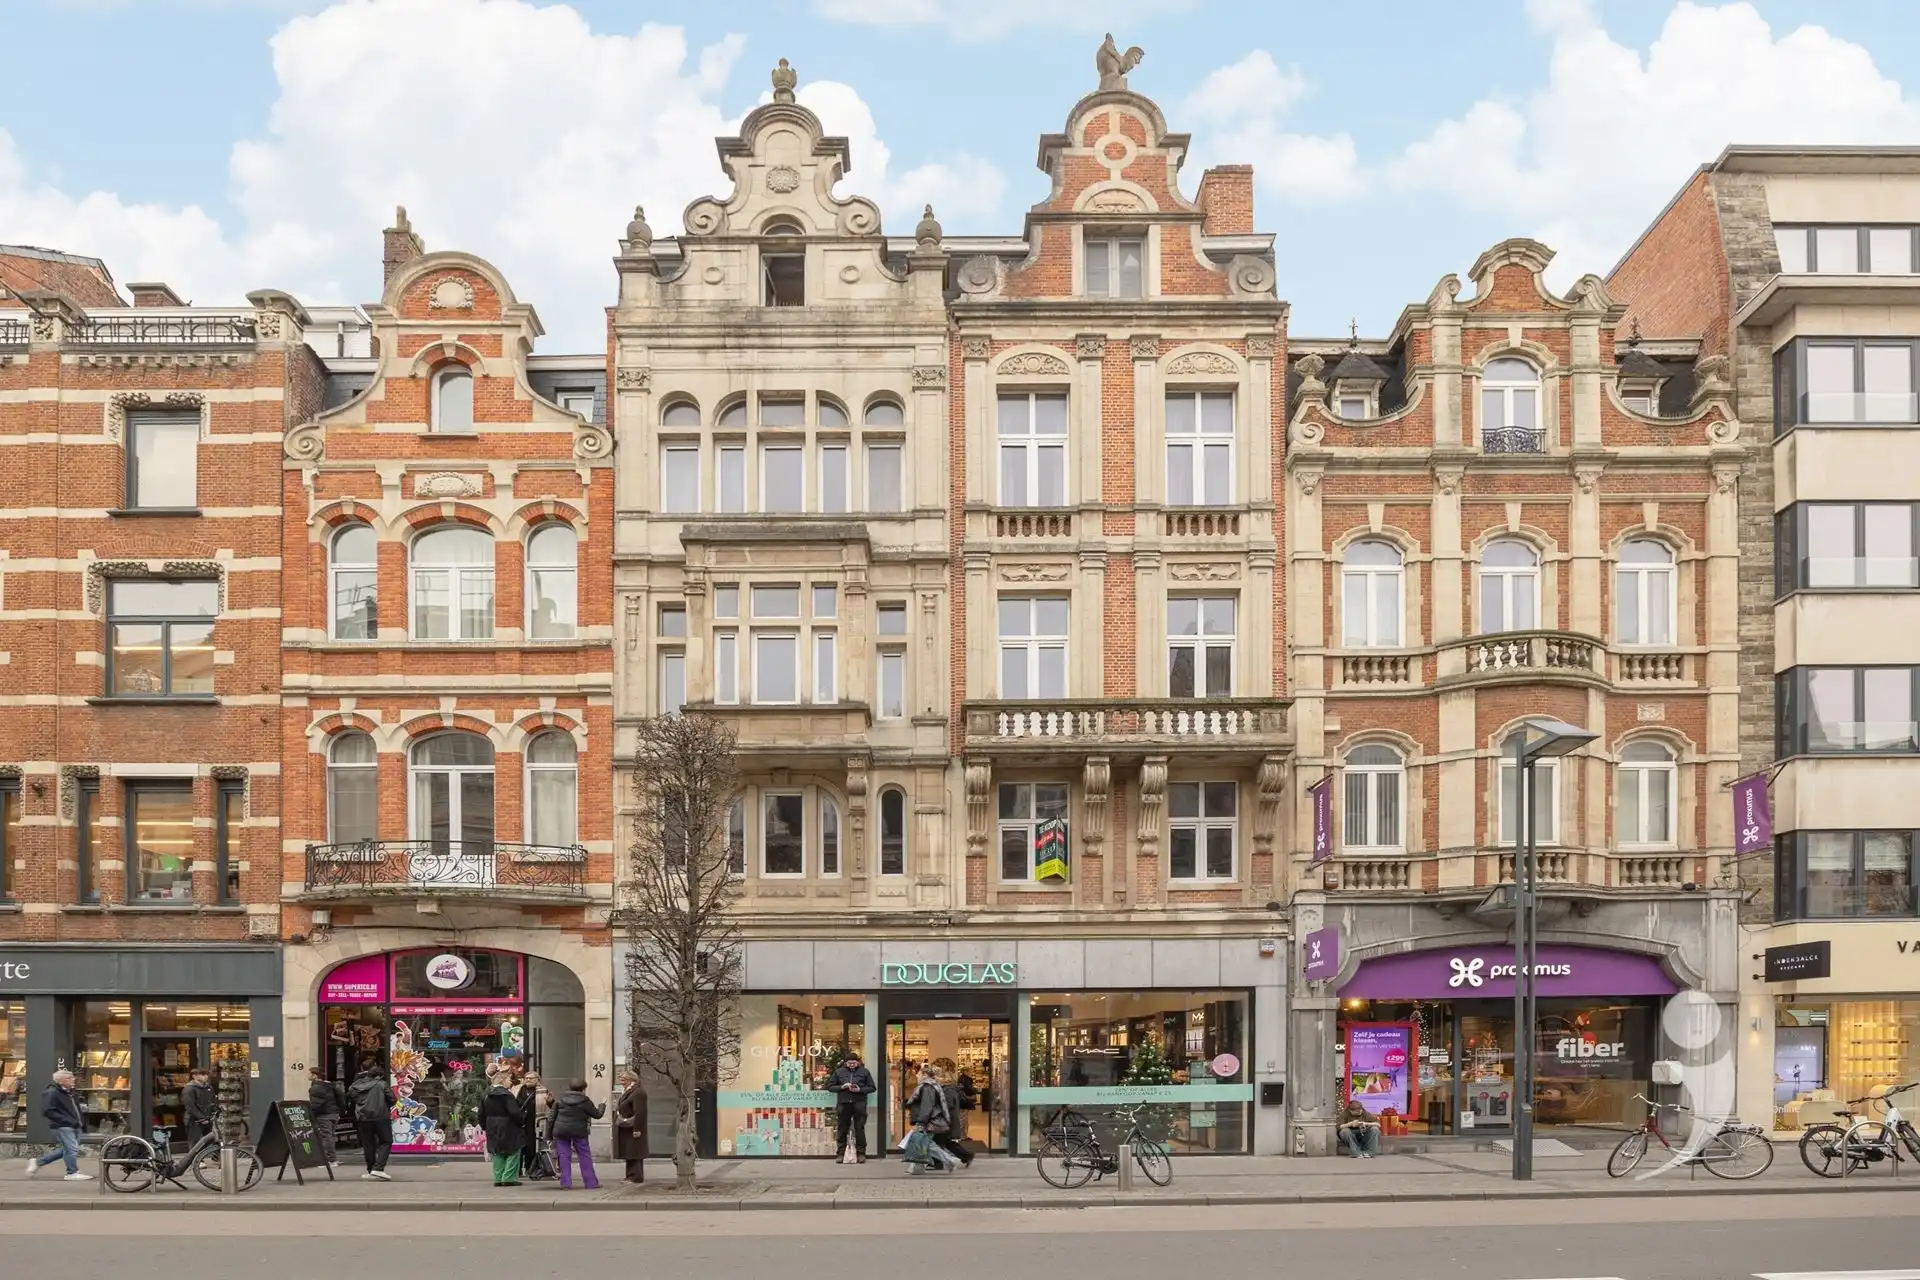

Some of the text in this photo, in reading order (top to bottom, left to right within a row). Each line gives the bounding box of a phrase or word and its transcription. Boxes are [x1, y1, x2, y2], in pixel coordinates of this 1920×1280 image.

[1746, 788, 1755, 826] proximus
[883, 962, 1015, 984] DOUGLAS
[1490, 964, 1571, 980] proxmus
[750, 1045, 833, 1057] GIVE JOY
[1556, 1038, 1624, 1057] fiber
[291, 1063, 304, 1071] 49
[448, 1060, 473, 1072] open
